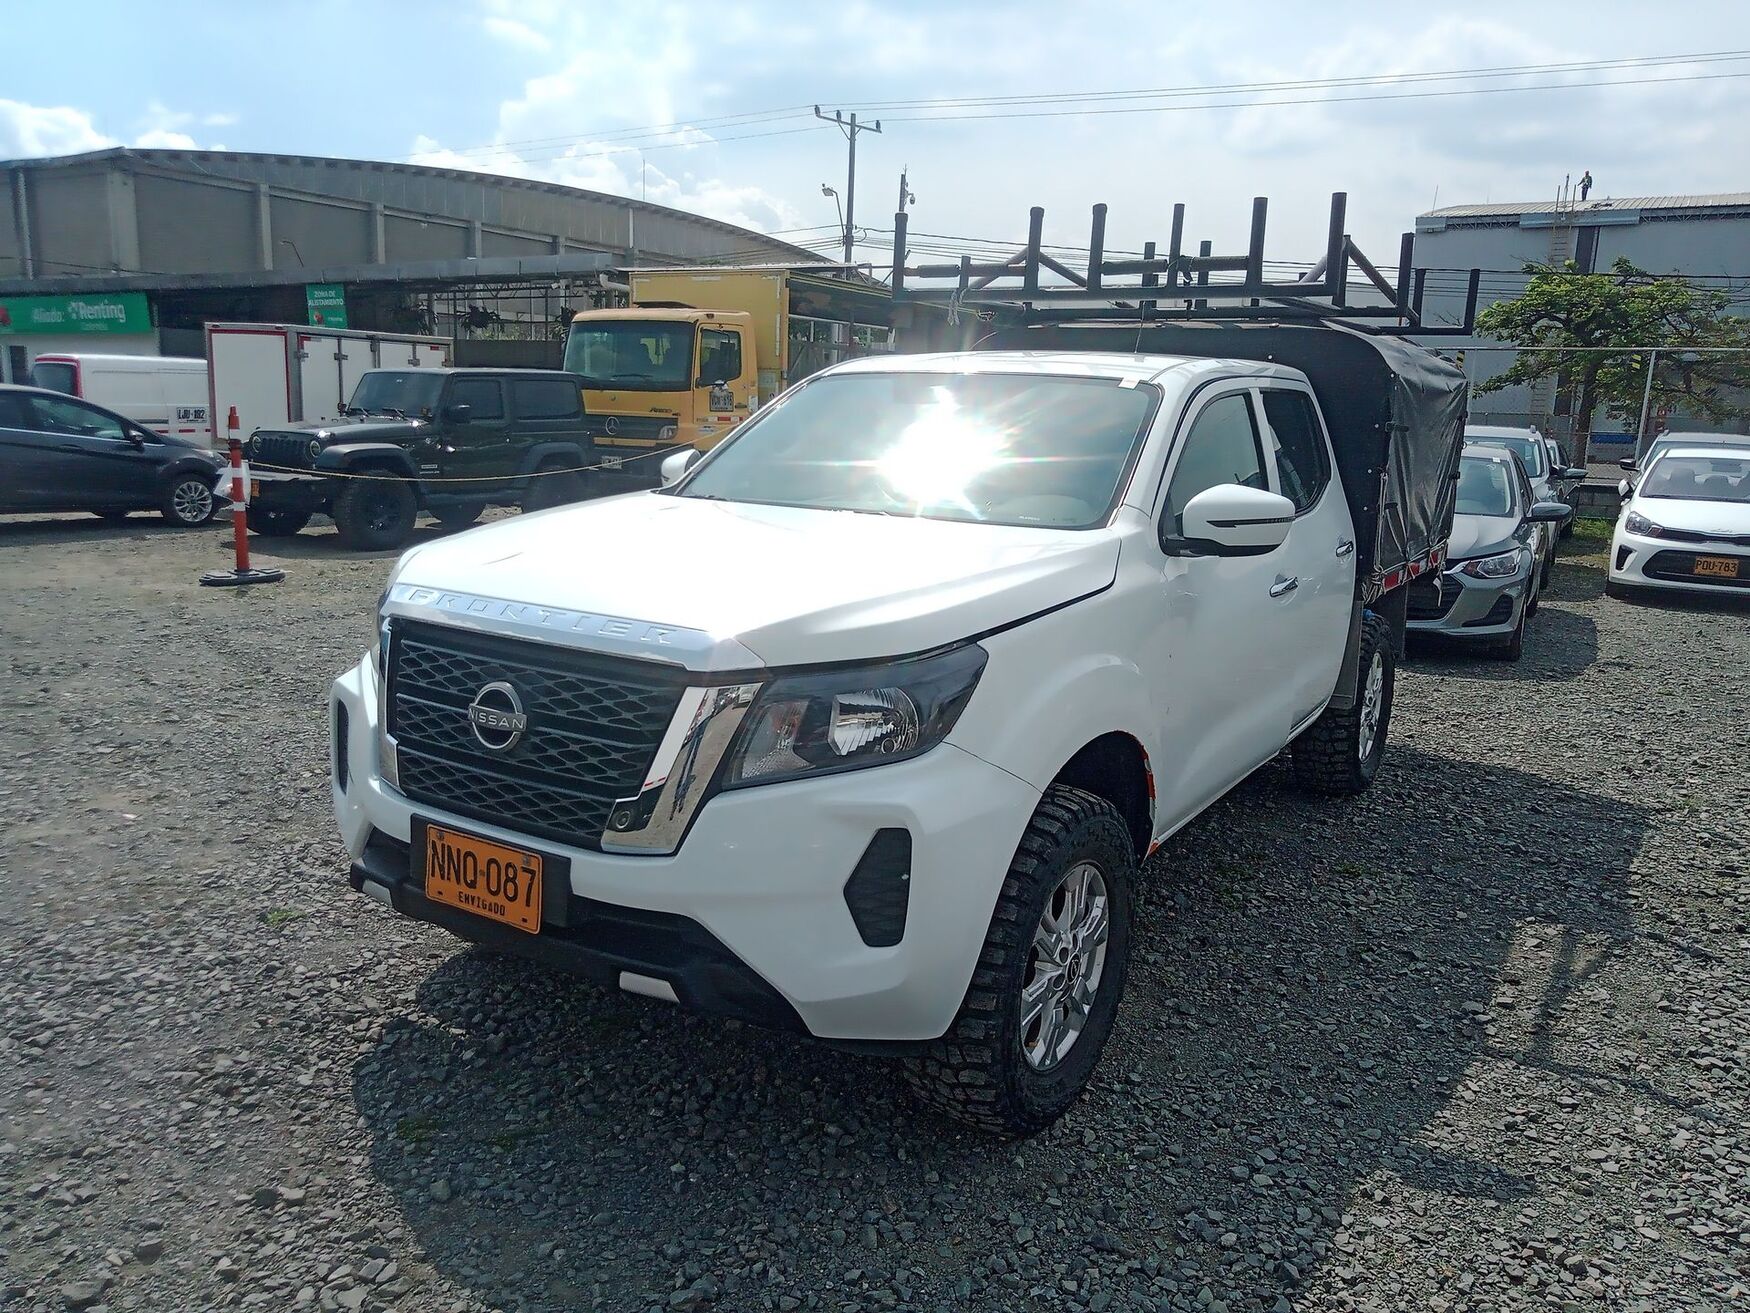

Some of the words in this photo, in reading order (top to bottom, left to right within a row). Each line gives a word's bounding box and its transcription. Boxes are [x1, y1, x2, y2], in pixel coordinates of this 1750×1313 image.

[79, 299, 126, 323] Renting
[408, 588, 678, 645] FRONTIER
[467, 707, 525, 730] NISSAN
[430, 839, 537, 908] NNQ-087
